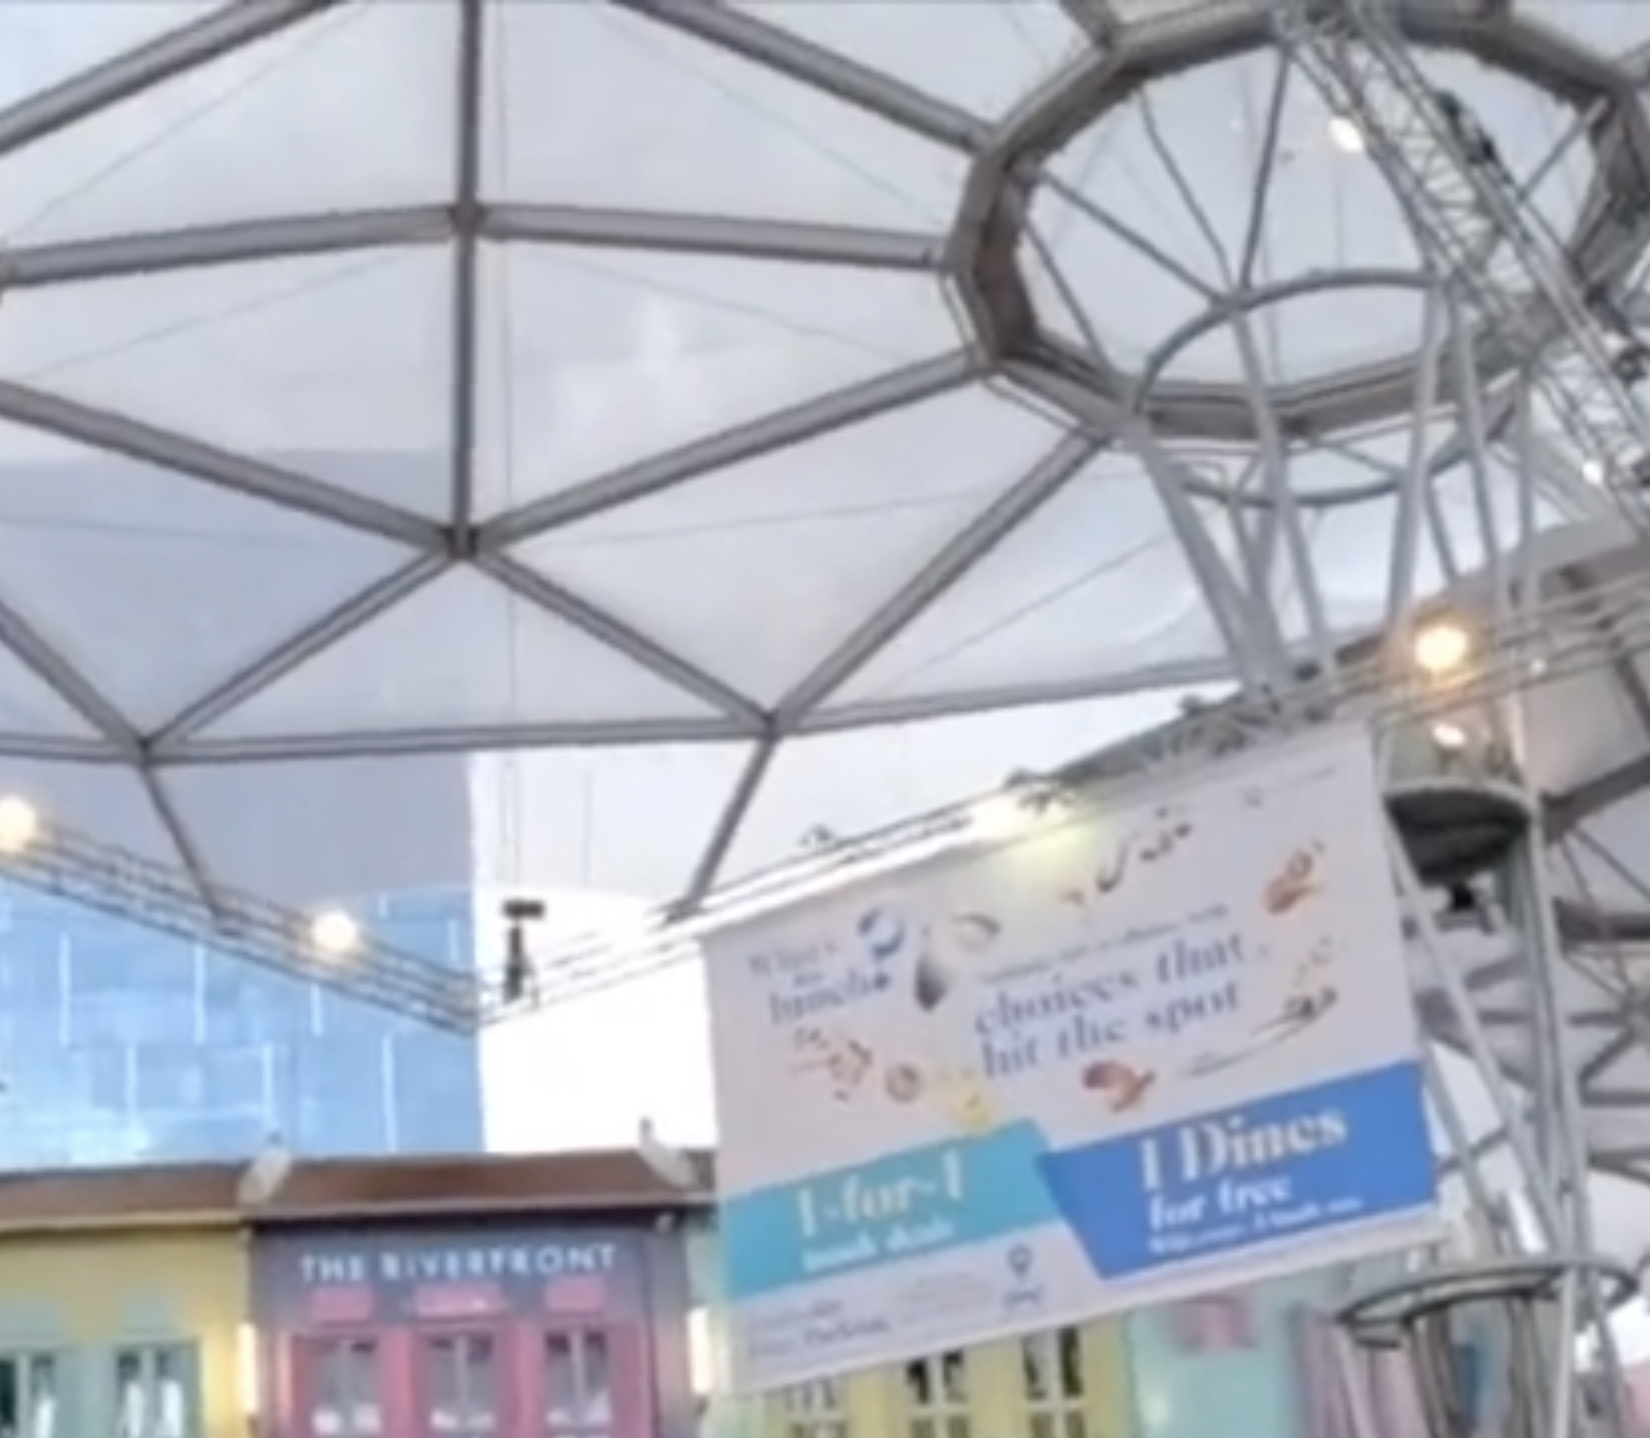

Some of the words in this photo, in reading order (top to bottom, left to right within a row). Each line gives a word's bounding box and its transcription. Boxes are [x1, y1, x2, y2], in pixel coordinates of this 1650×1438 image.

[975, 972, 1139, 1035] choices
[1156, 932, 1244, 983] that
[981, 1028, 1040, 1079] hit
[1058, 1012, 1127, 1058] the
[1145, 981, 1238, 1034] spot
[1178, 1111, 1347, 1182] Dines
[1150, 1192, 1207, 1232] for
[1217, 1175, 1293, 1214] free
[301, 1253, 365, 1281] THE
[380, 1242, 618, 1281] RIVERFRONT
